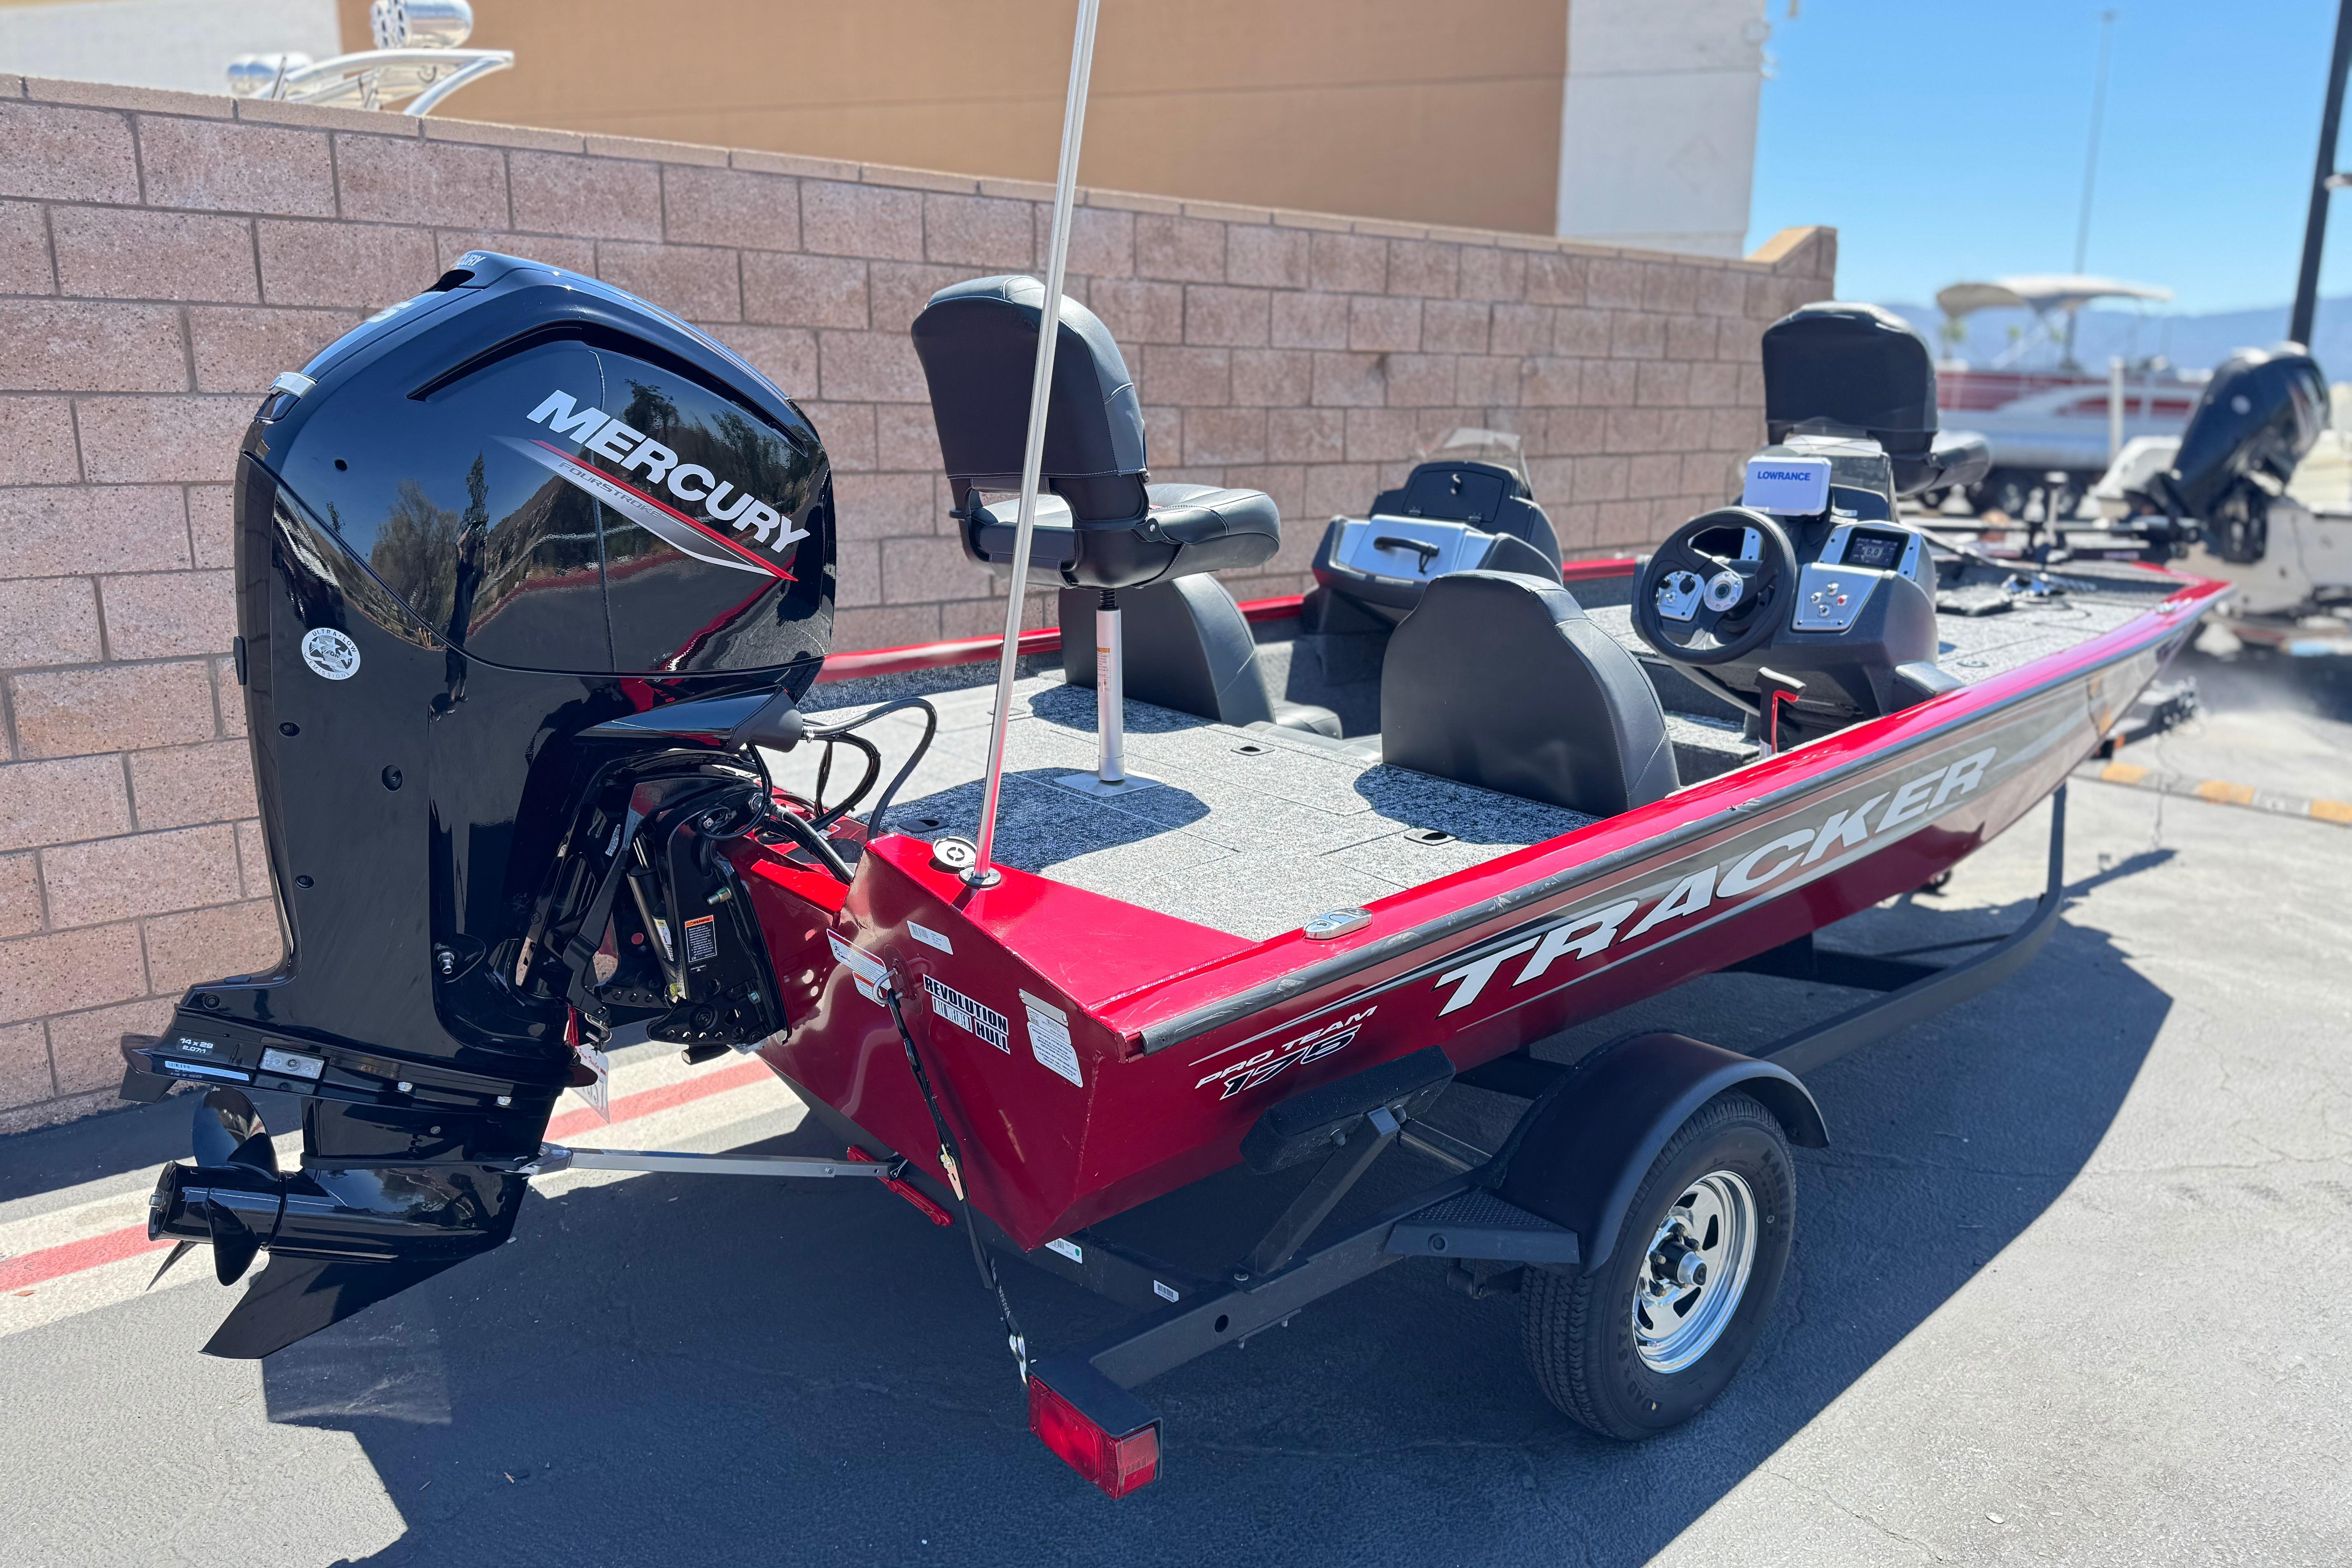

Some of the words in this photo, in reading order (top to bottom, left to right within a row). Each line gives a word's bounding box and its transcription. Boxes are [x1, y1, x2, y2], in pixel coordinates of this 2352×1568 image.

[527, 390, 810, 553] MERCURY
[559, 461, 661, 518] FOURSTROKE
[1757, 471, 1811, 481] LOWRANCE
[343, 637, 357, 652] LOW
[309, 660, 346, 679] EMISSION
[1431, 746, 1997, 1018] TRACKER
[924, 976, 1007, 1033] REVOLUTION
[936, 1000, 946, 1016] ALL
[945, 1005, 969, 1029] WELDED
[182, 1045, 206, 1053] 2.07:1
[976, 1021, 1009, 1052] HULL
[1195, 1049, 1274, 1090] PRO
[1281, 1005, 1378, 1051] TEAM
[1219, 1023, 1362, 1101] 175
